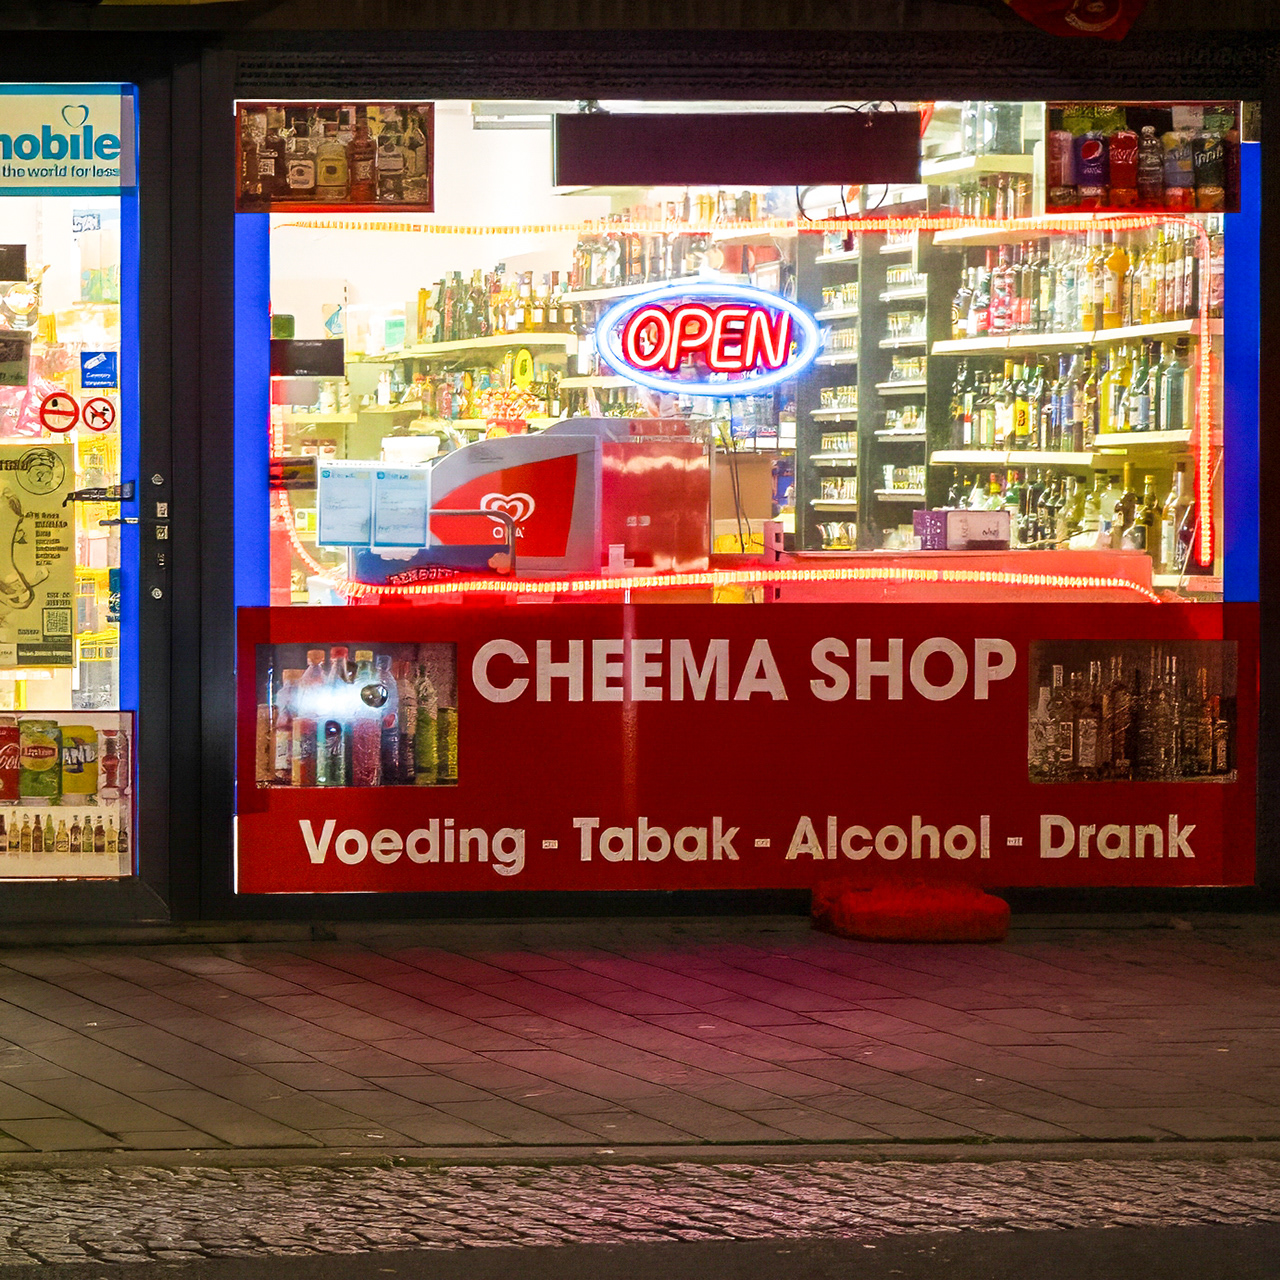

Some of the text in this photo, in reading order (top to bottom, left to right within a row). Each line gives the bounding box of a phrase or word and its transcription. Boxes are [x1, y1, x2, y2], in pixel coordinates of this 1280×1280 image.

[2, 164, 25, 177] the
[28, 164, 67, 177] world
[71, 165, 91, 177] for
[93, 165, 121, 177] less
[624, 305, 791, 370] OPEN
[493, 526, 524, 539] OA
[472, 637, 1017, 703] CHEEMA SHOP
[298, 818, 526, 877] Voeding
[573, 817, 740, 862] Tabak
[785, 815, 991, 860] Alcohol
[1040, 814, 1196, 860] Drank
